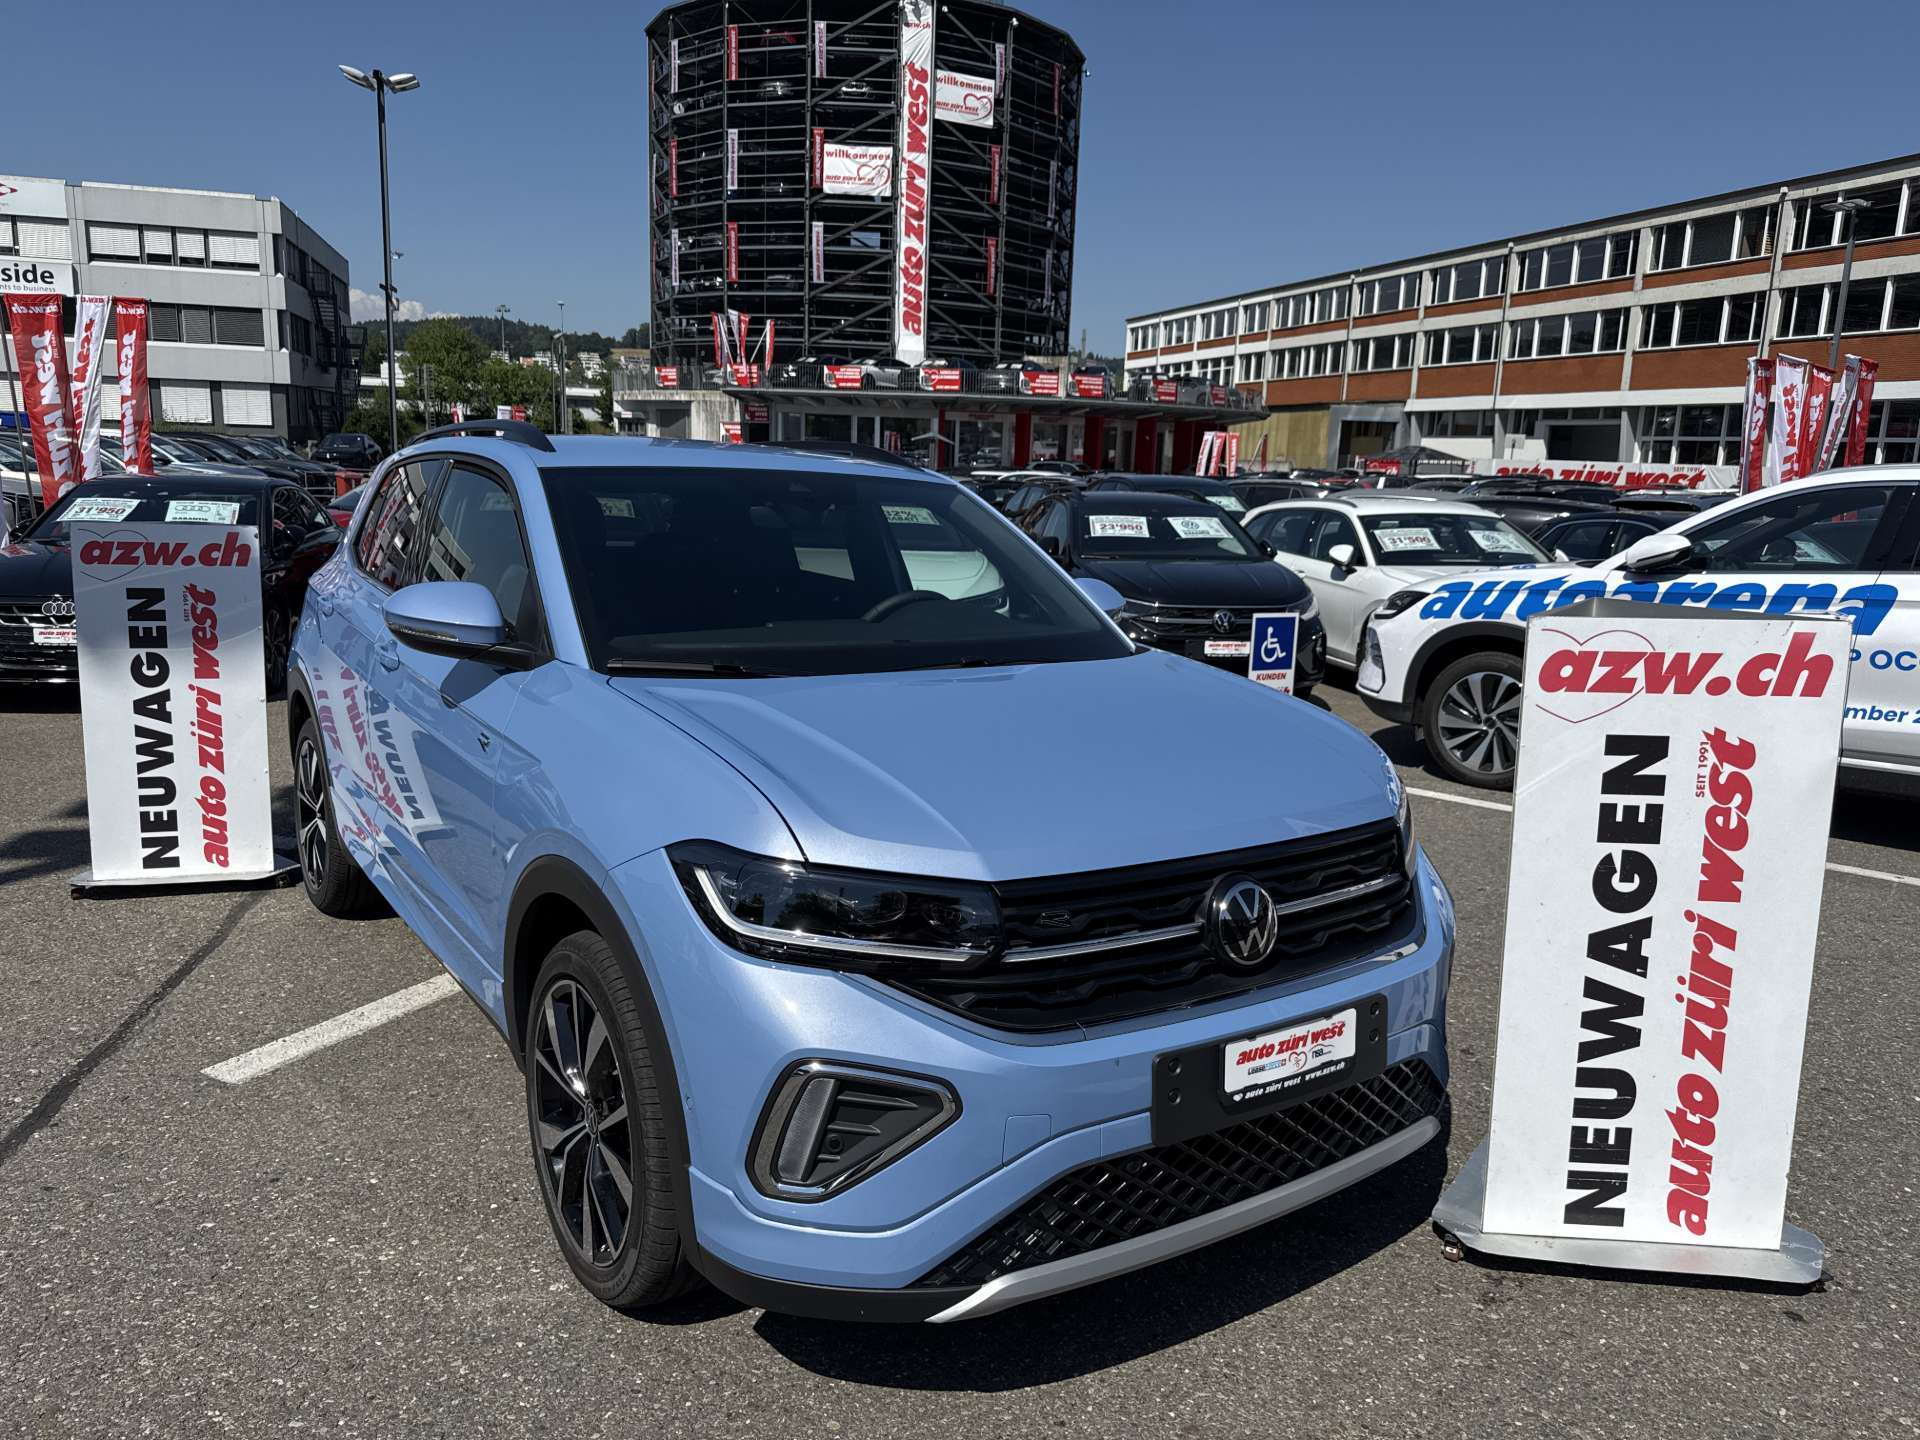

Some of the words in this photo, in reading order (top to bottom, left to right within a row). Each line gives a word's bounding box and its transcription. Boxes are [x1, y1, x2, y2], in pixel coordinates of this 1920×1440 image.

[907, 61, 929, 153] west
[901, 157, 927, 245] züri
[0, 263, 54, 284] side
[23, 285, 56, 293] business
[900, 246, 924, 336] auto
[80, 532, 252, 567] azw.ch
[183, 583, 220, 679] west
[1538, 631, 1834, 698] azw.ch
[1869, 650, 1920, 671] OC
[1255, 672, 1287, 681] KUNDEN
[126, 587, 181, 869] NEUWAGEN
[188, 684, 225, 775] züri
[1698, 740, 1709, 770] 1991
[194, 775, 229, 868] auto
[1695, 772, 1706, 798] SEIT
[1697, 727, 1757, 903] west
[1563, 734, 1670, 1228] NEUWAGEN
[1674, 908, 1737, 1073] züri
[1236, 1042, 1275, 1066] auto
[1276, 1030, 1310, 1056] züri
[1311, 1021, 1345, 1044] west
[1663, 1073, 1719, 1236] auto
